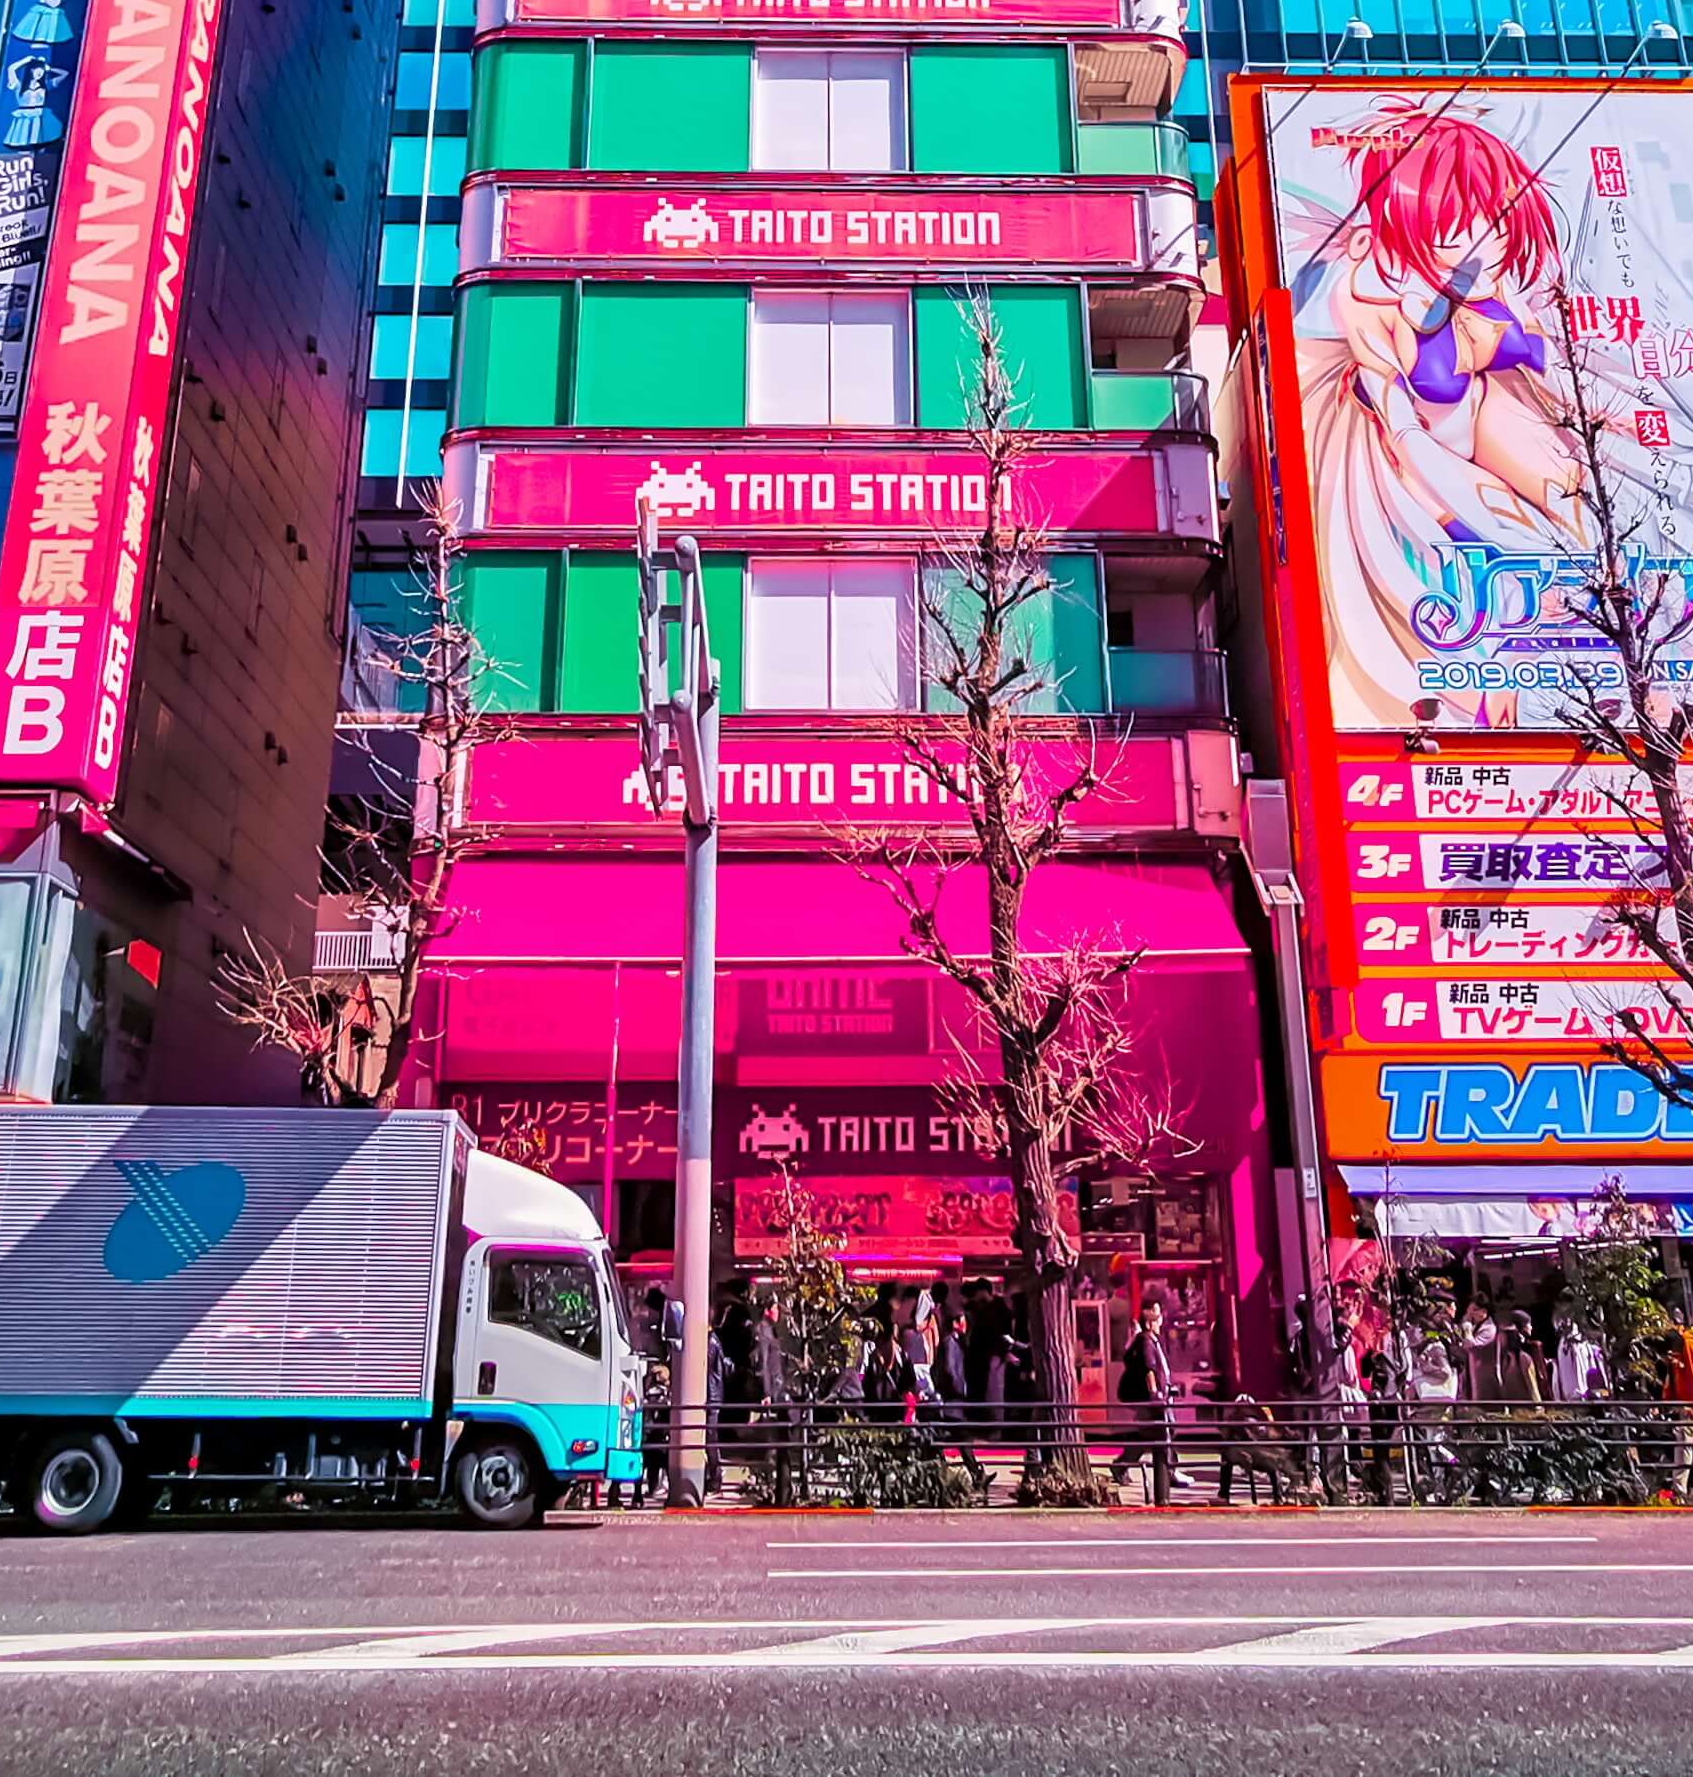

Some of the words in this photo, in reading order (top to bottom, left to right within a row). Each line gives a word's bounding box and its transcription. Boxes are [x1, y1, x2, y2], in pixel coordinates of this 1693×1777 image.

[728, 210, 833, 244] TAITO
[846, 211, 1001, 246] STATION
[1569, 296, 1645, 344] 世界
[725, 474, 835, 511] TAITO
[719, 763, 835, 804] TAITO
[1348, 776, 1405, 806] 4F
[1425, 767, 1463, 786] 新品
[1472, 767, 1509, 786] 中古
[1358, 845, 1412, 878] 3F
[1363, 917, 1420, 951] 2F
[1441, 908, 1480, 928] 新品
[1490, 908, 1528, 928] 中古
[1382, 993, 1428, 1026] 1F
[1450, 983, 1489, 1004] 新品
[1499, 983, 1539, 1004] 中古
[817, 1117, 915, 1152] TAITO
